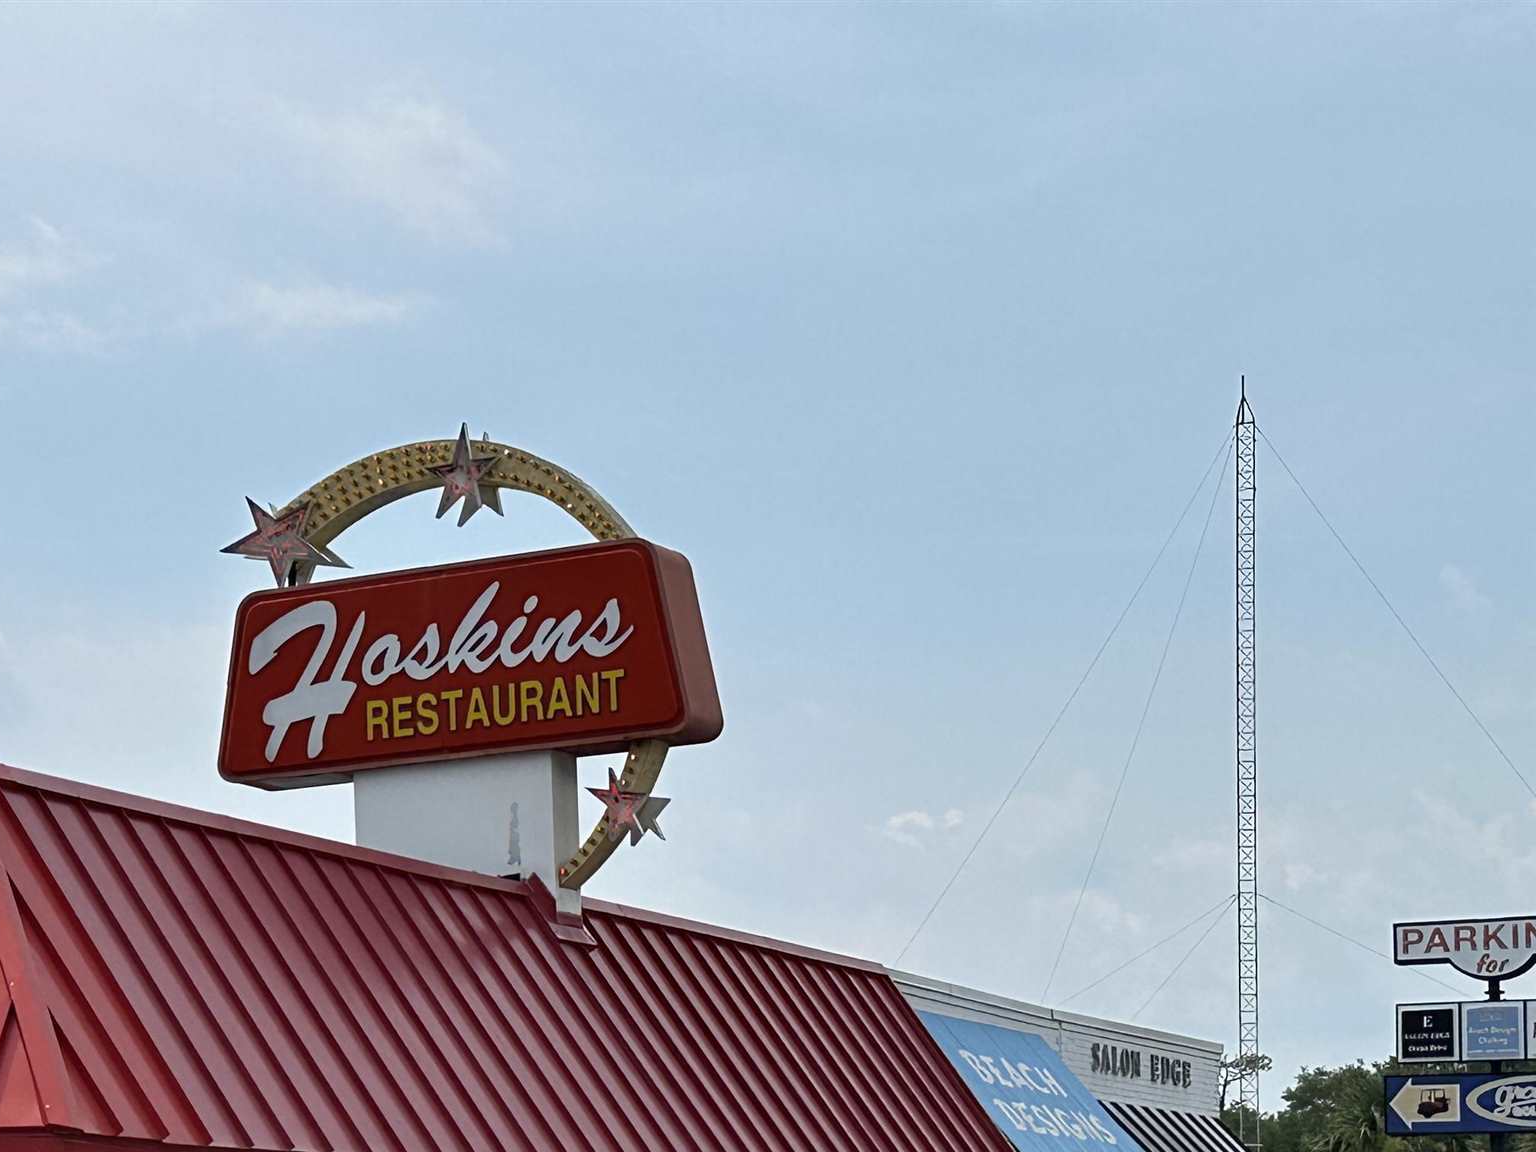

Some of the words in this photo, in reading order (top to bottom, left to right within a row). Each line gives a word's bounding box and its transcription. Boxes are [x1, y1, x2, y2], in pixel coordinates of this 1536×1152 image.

[248, 581, 634, 763] Hoskins
[366, 669, 626, 742] RESTAURANT
[1476, 953, 1510, 974] for
[958, 1049, 1068, 1098] BEACH
[1090, 1043, 1141, 1080] SALON
[1150, 1054, 1192, 1089] EDGE
[993, 1098, 1117, 1145] DESIGNS
